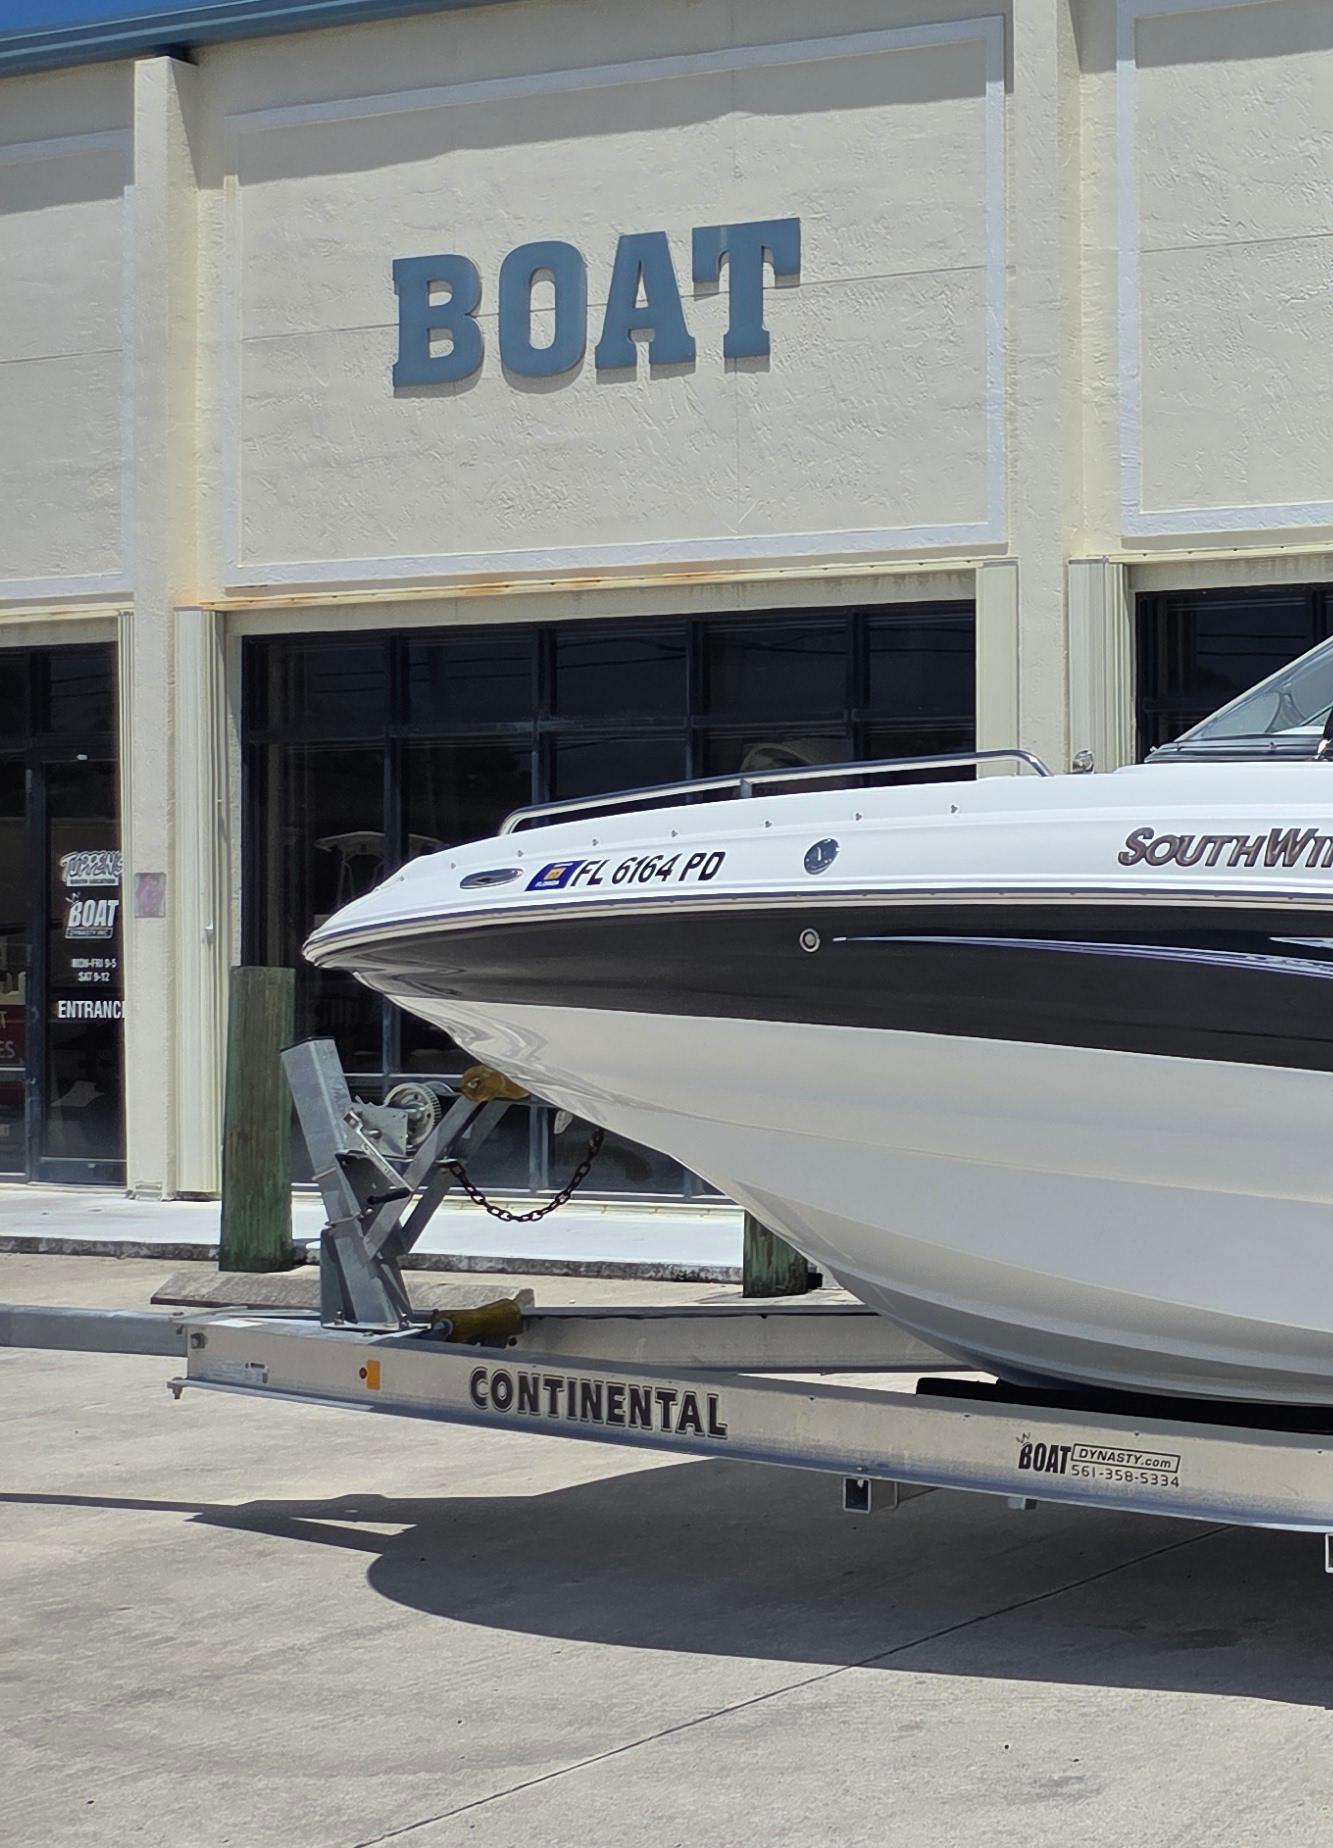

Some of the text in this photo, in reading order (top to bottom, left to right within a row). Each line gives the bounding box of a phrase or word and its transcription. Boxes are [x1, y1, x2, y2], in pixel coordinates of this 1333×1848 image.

[392, 217, 800, 388] BOAT
[570, 851, 726, 887] FL 6164 PD
[68, 899, 119, 927] BOAT
[470, 1366, 728, 1439] CONTINENTAL
[1018, 1442, 1172, 1474] BOAT DYNASTY.com
[1071, 1464, 1179, 1488] 561-358-5334
